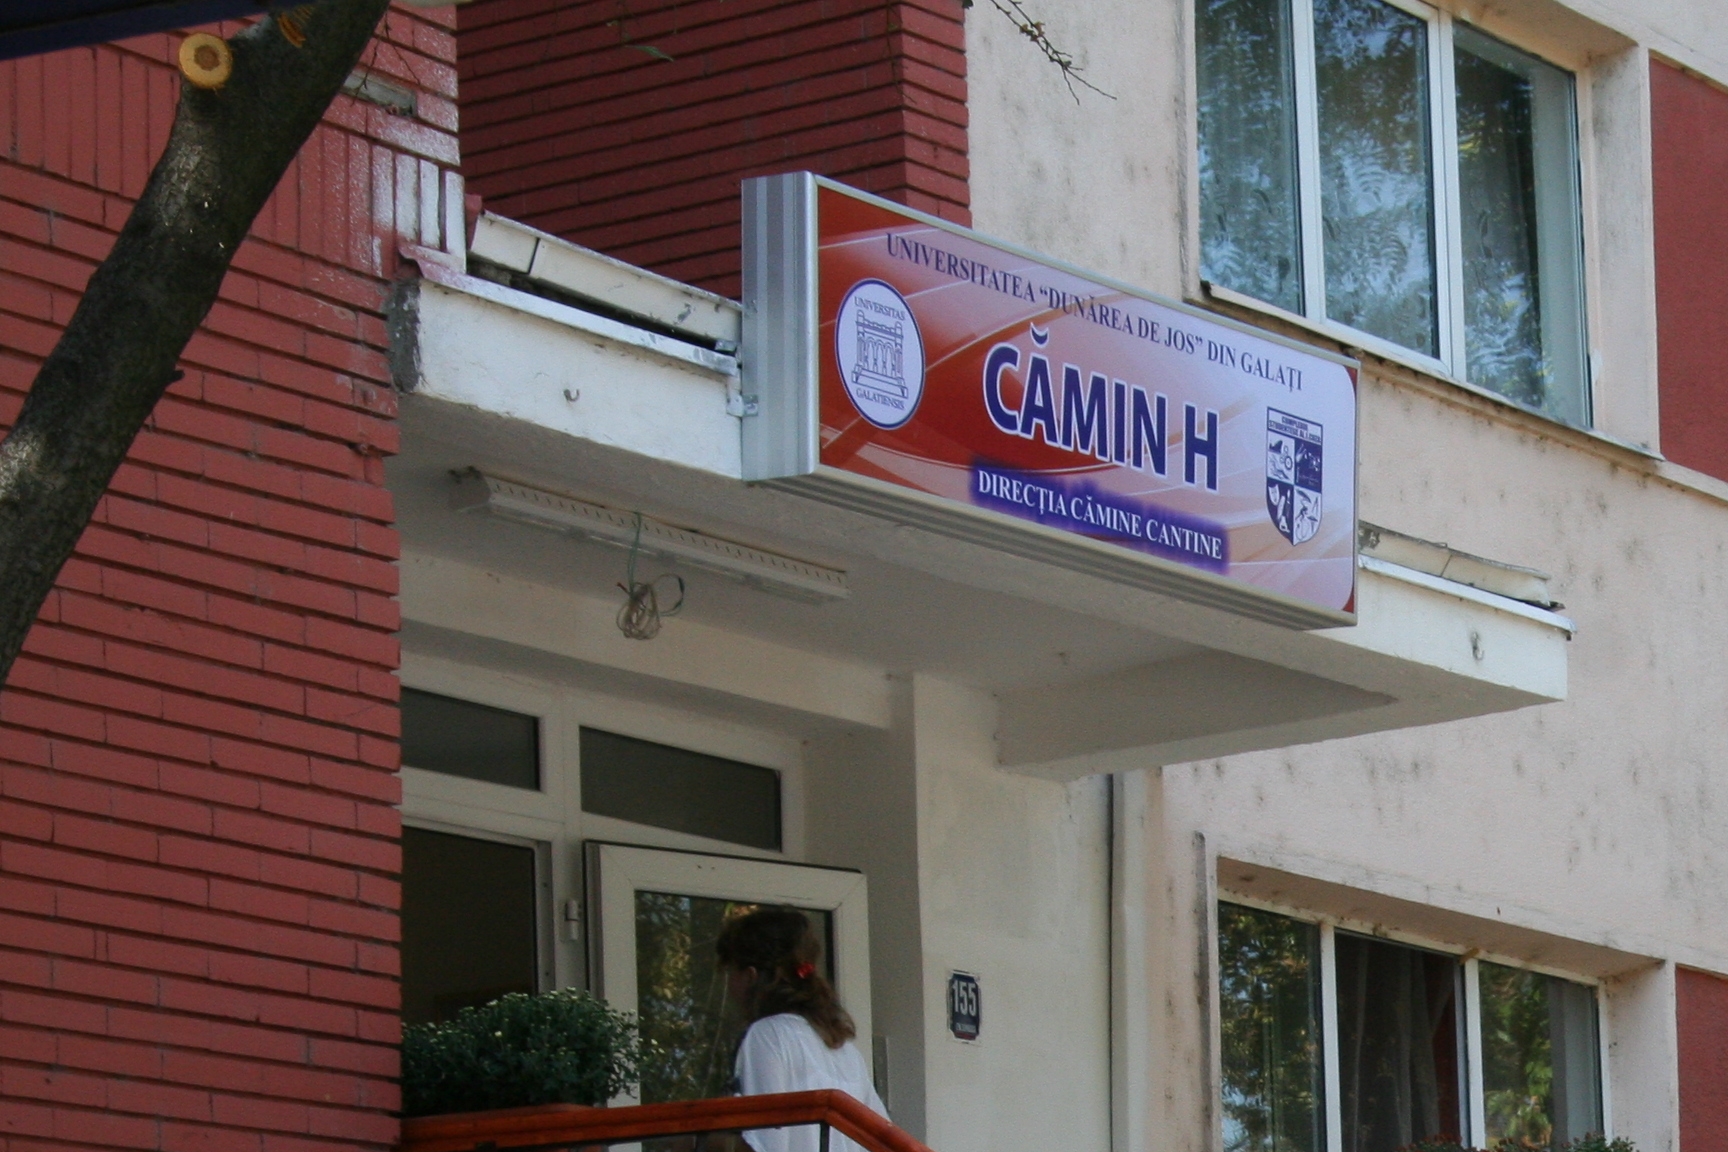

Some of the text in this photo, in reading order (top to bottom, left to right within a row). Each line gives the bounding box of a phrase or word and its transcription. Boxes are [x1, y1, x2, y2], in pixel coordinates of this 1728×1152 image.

[854, 296, 906, 320] UNIVERSITAS
[887, 233, 1035, 303] UNIVERSITATEA
[1138, 317, 1160, 343] DE
[1208, 340, 1236, 368] DIN
[855, 388, 905, 410] GALATIENSIS
[984, 323, 1219, 492] CĂMIN H
[1070, 494, 1141, 537] CĂMINE
[1145, 518, 1222, 560] CANTINE
[952, 980, 976, 1016] 155
